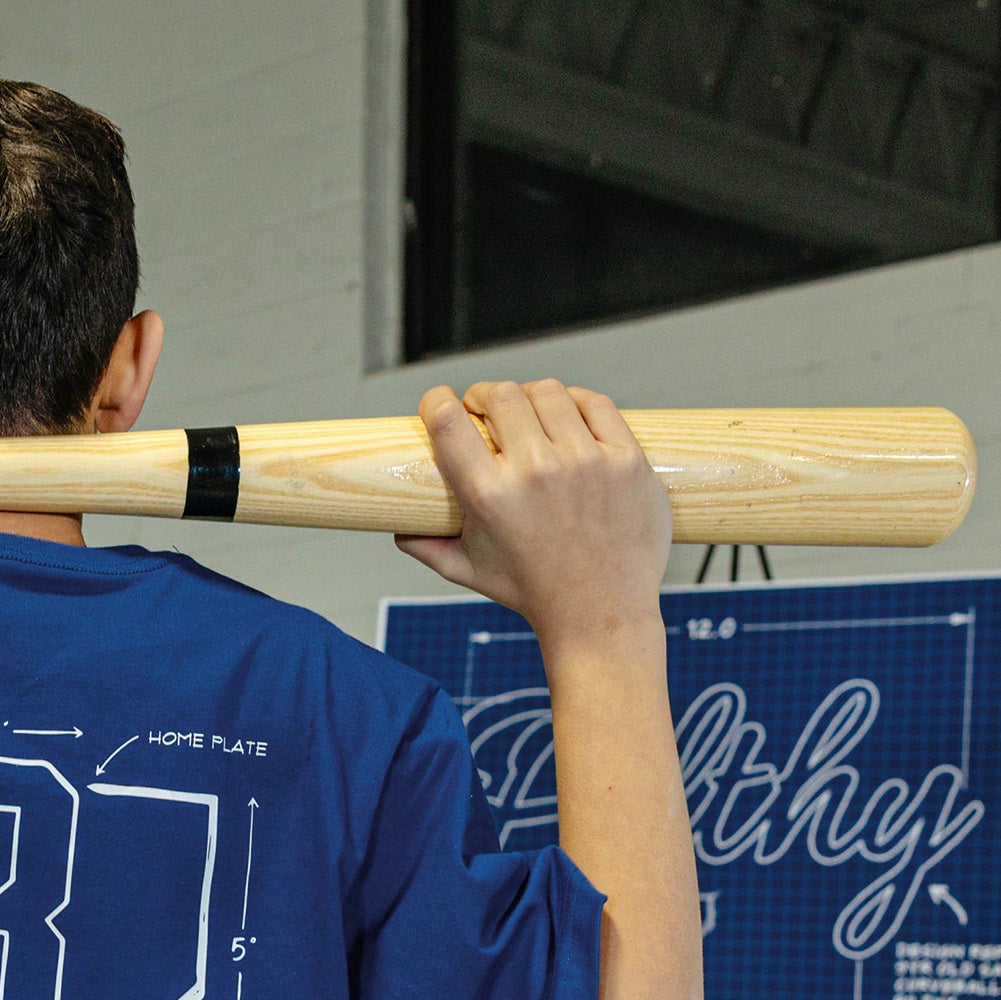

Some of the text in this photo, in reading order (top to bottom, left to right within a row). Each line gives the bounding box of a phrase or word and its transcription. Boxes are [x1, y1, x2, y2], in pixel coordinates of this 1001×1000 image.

[686, 616, 738, 640] 12.0
[148, 730, 268, 757] HOME PLATE
